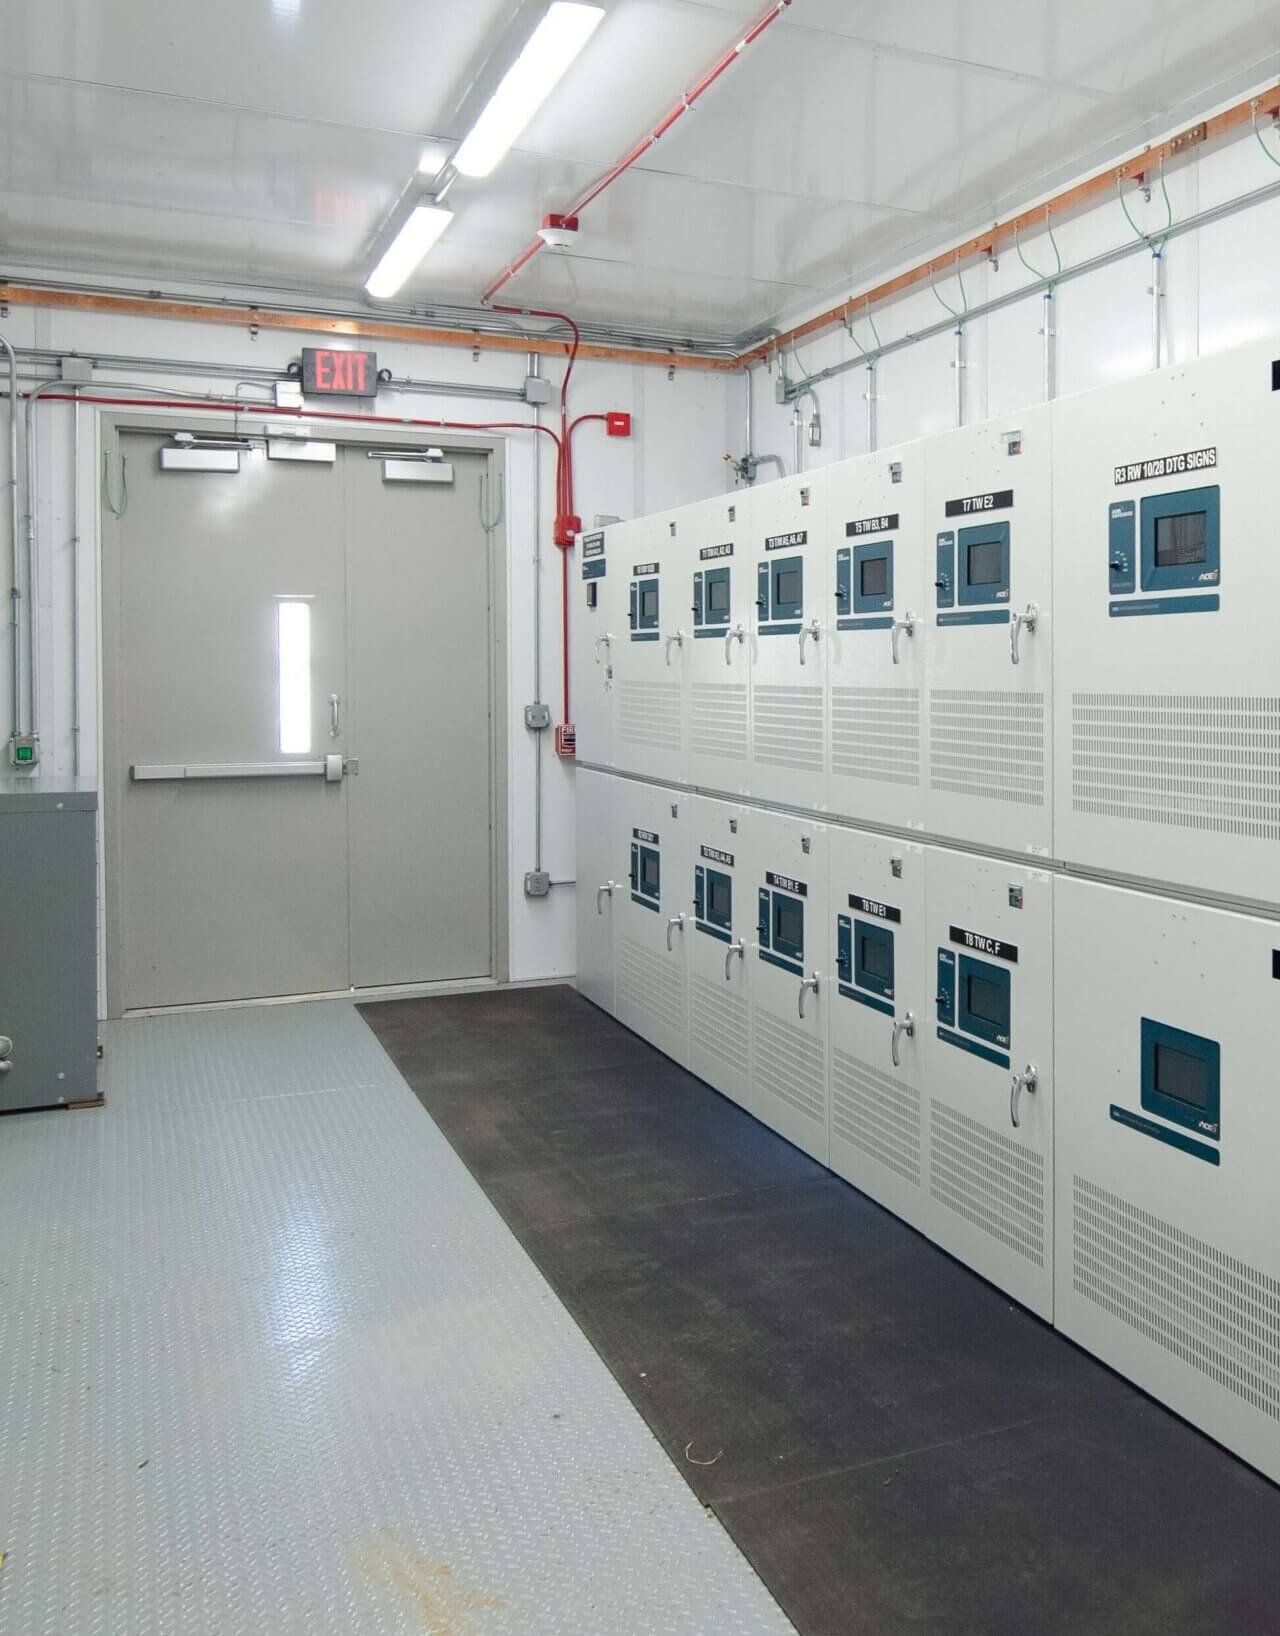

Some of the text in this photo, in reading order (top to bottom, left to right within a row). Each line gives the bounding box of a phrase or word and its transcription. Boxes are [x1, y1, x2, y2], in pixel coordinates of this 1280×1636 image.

[315, 351, 369, 392] EXIT
[1114, 448, 1216, 484] R3 RW 10/28 DTG SIGNS
[962, 495, 995, 513] T7 TW E2
[855, 522, 863, 534] T5
[862, 521, 872, 532] TW
[869, 902, 879, 914] TW
[964, 932, 1001, 954] T8 TW C, F
